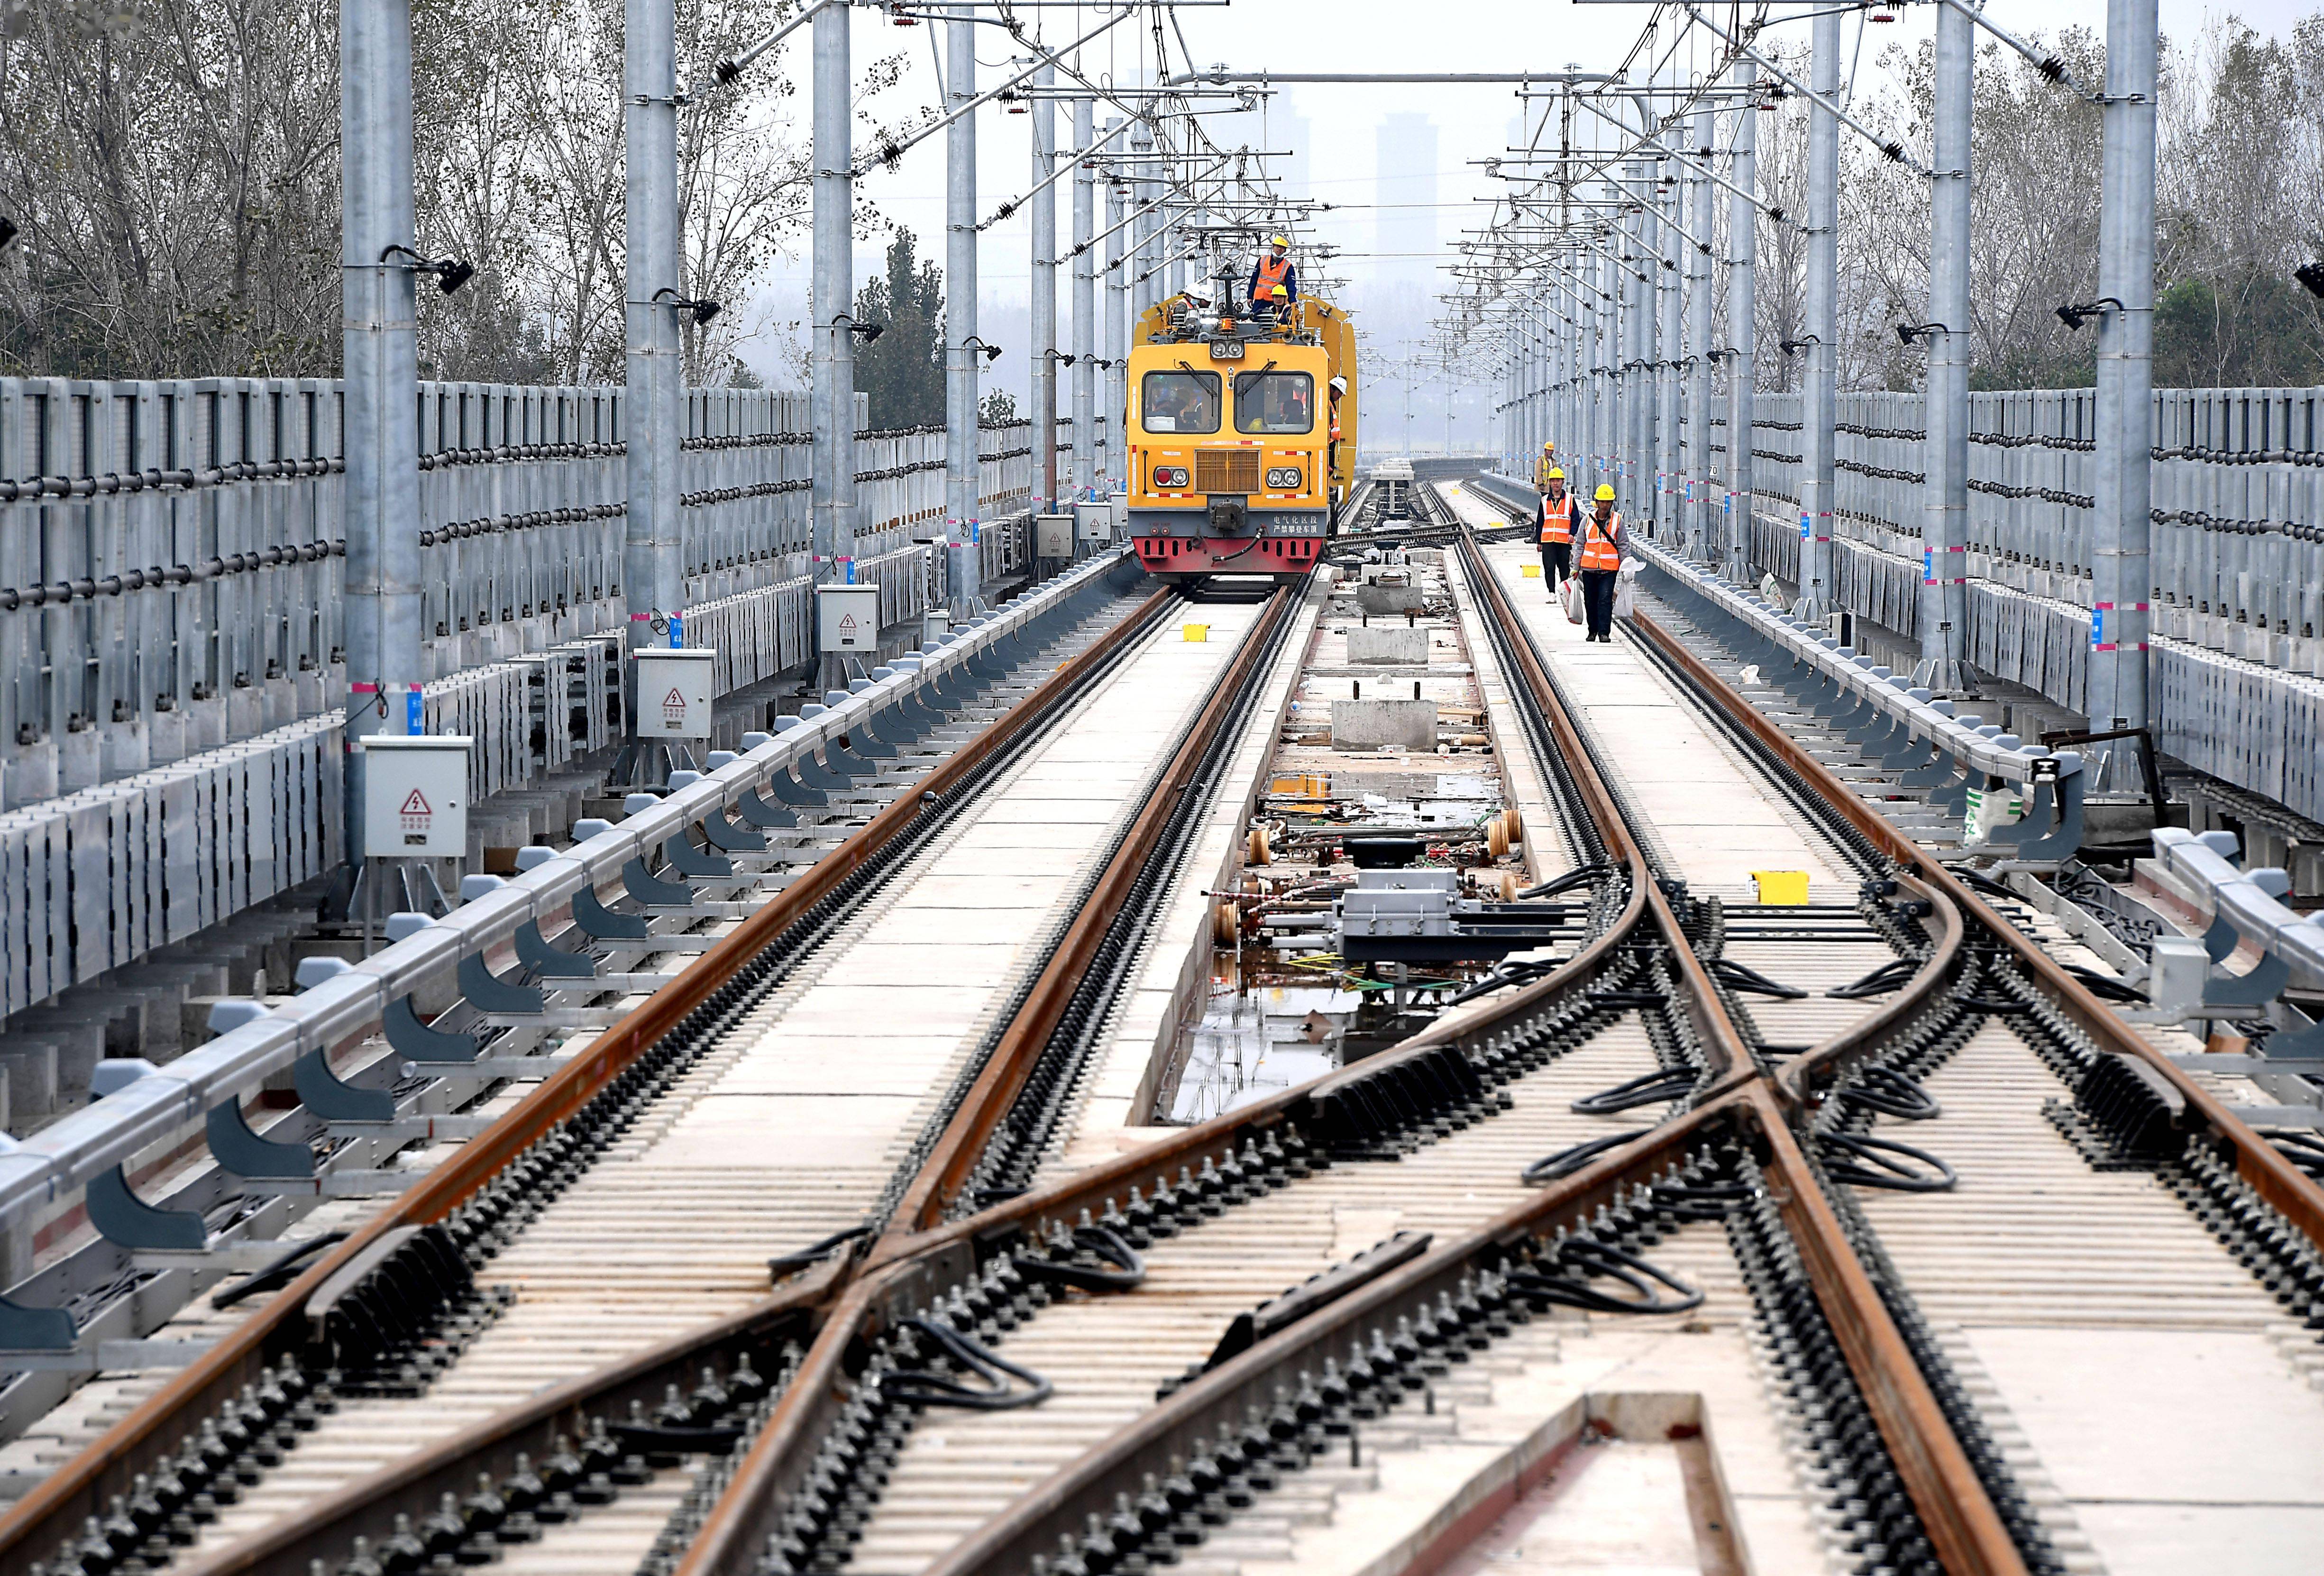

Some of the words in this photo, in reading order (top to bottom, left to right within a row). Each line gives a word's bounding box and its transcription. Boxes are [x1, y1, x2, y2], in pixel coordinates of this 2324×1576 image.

[1274, 516, 1317, 524] 电气化区段
[1273, 525, 1317, 533] 严禁攀登车顶
